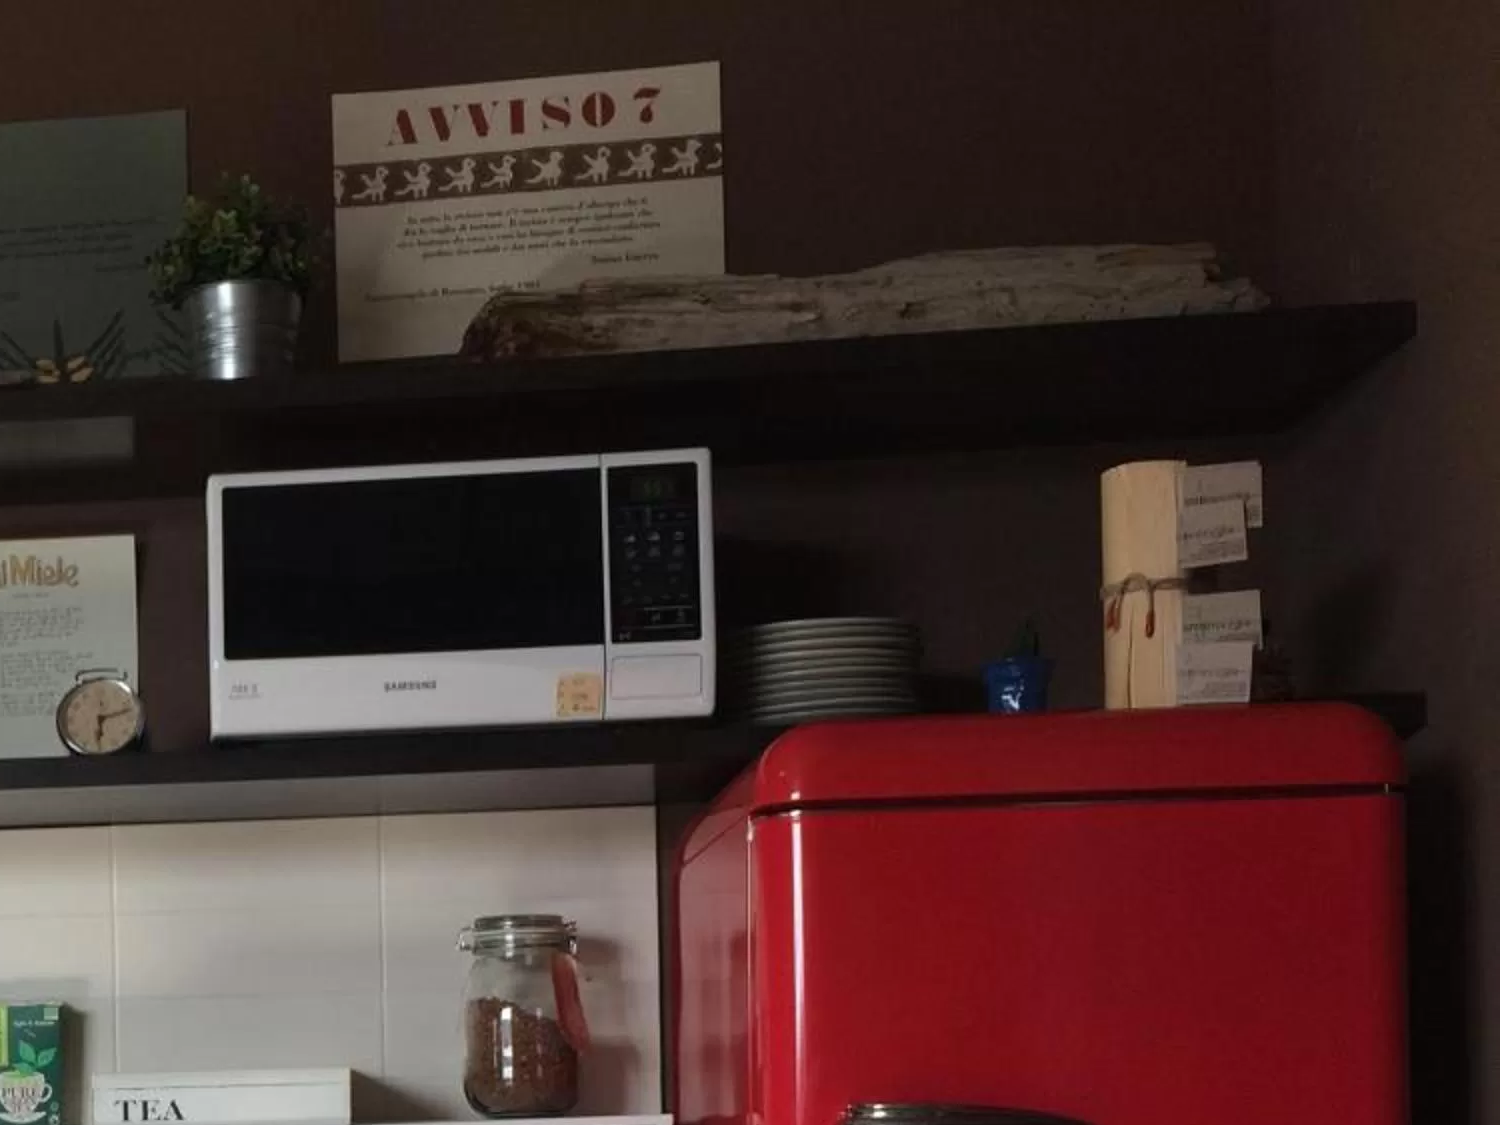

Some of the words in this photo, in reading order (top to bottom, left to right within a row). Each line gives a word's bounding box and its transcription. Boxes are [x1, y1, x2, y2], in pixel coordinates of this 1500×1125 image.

[387, 90, 616, 147] AVVISO
[633, 85, 662, 125] 7
[9, 553, 80, 589] Miele
[384, 680, 437, 693] SAMSUNG
[114, 1099, 184, 1121] TEA
